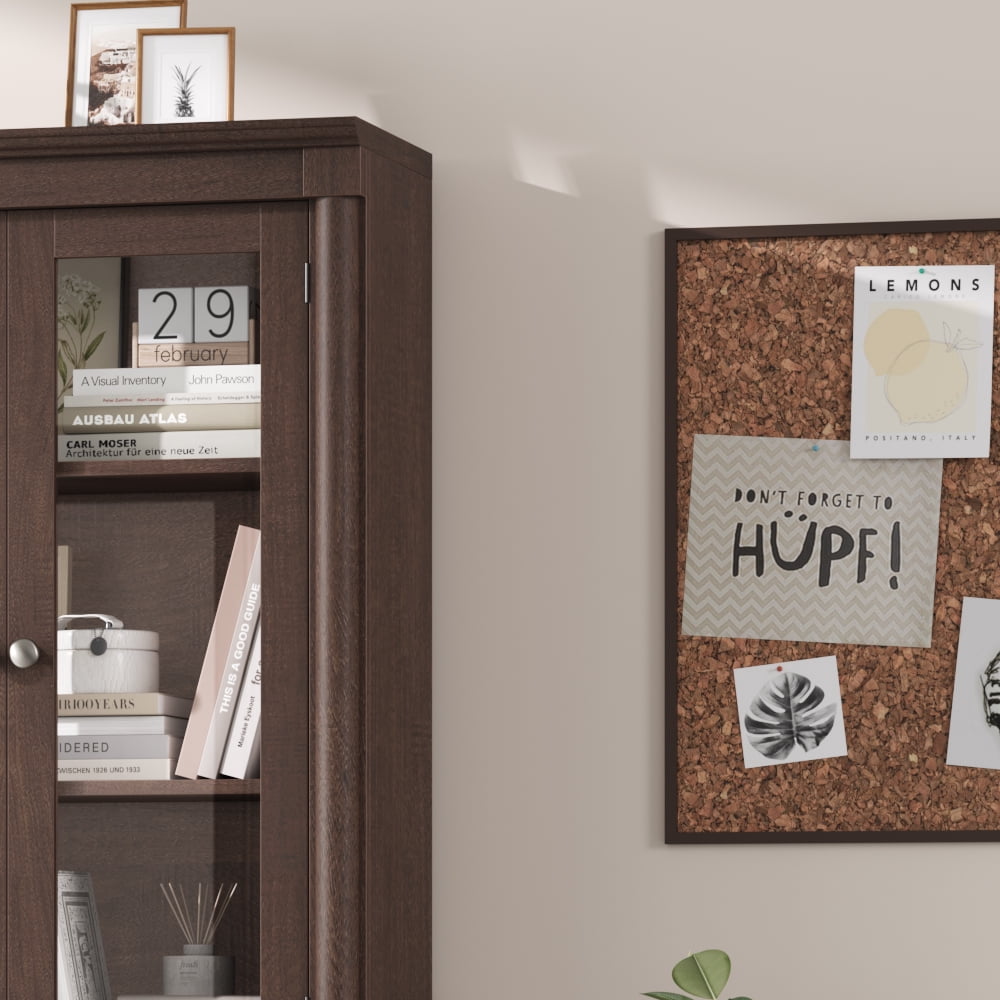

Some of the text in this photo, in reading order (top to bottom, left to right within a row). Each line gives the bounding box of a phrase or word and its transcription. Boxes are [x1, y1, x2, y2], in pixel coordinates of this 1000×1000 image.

[869, 278, 980, 291] LEMONS
[154, 344, 228, 364] february
[81, 375, 167, 388] A Visual Inventory
[188, 373, 254, 385] John Pawson
[72, 412, 188, 426] AUSBAU ATLAS
[66, 439, 137, 449] CARL MOSER
[65, 446, 218, 458] Architektur für eine neue Zeit
[734, 488, 893, 510] DON'T FORGET TO
[732, 510, 900, 590] HÜPF!
[219, 583, 260, 713] THIS IS A GOOD GUIDE
